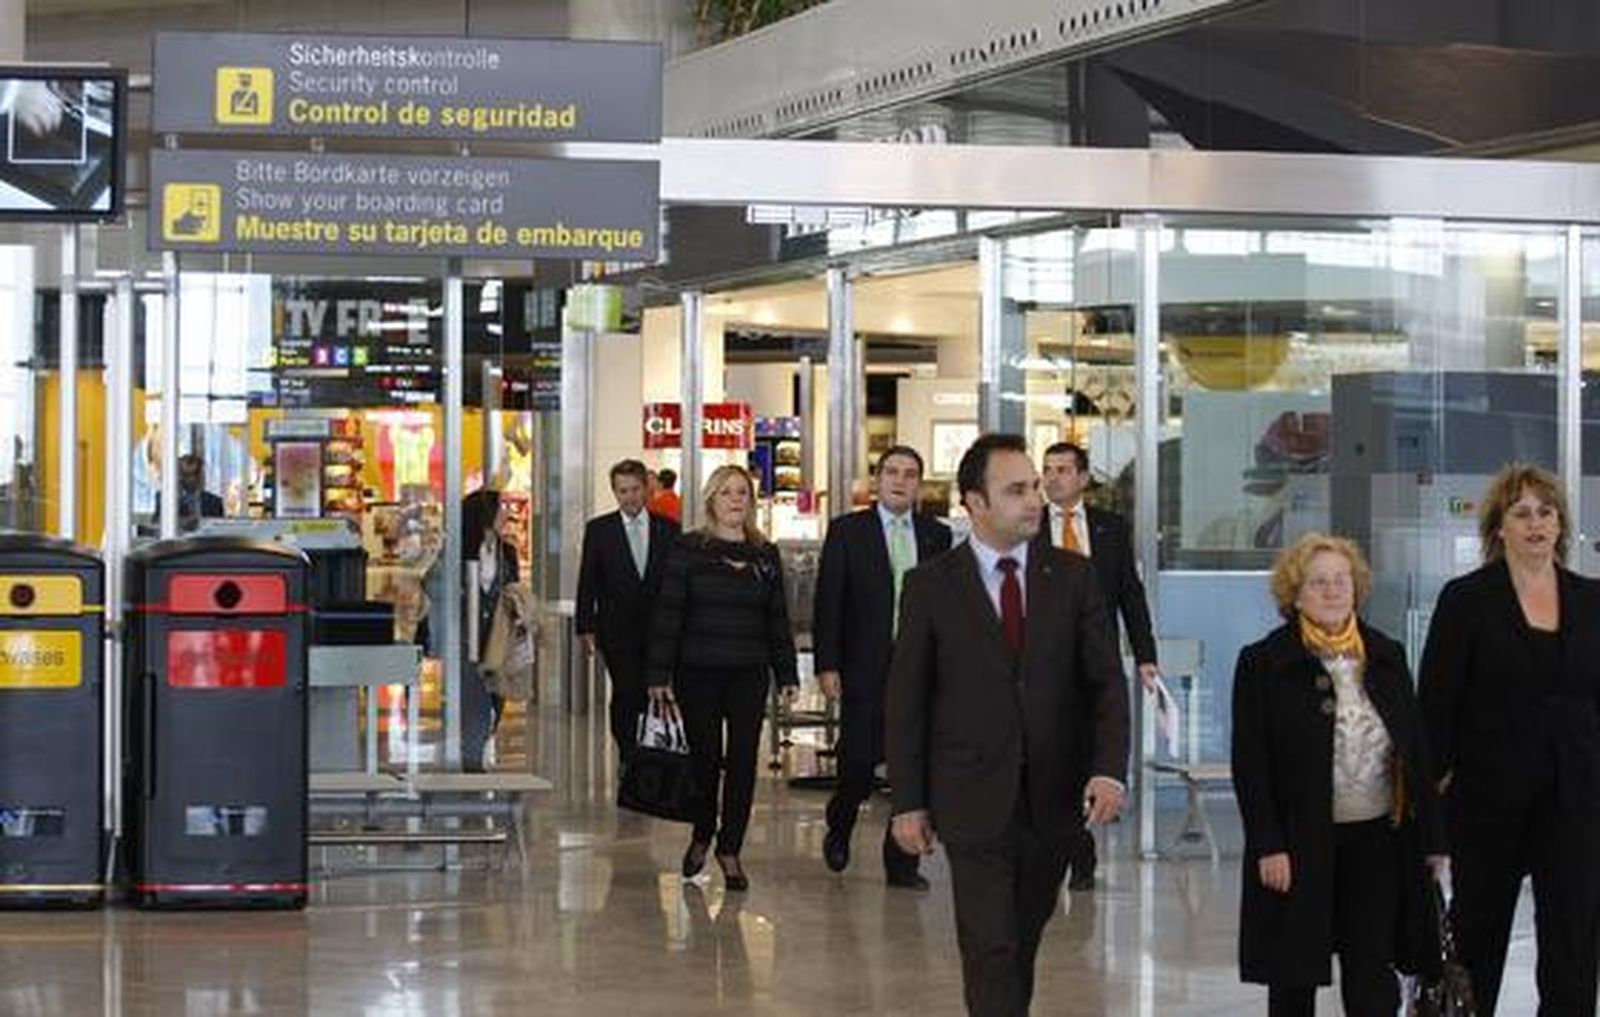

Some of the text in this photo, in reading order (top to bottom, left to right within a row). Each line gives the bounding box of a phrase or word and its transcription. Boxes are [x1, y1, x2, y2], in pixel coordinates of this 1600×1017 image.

[289, 42, 500, 70] Sicherheitskontrolle
[289, 69, 459, 97] Security control
[289, 98, 577, 131] Control de seguridad
[236, 159, 511, 192] Bitte Bordkarte vorzeigen
[236, 186, 505, 217] Show your boarding card
[236, 214, 643, 252] Muestre su tarjeta de embarque
[335, 298, 430, 343] FRE
[645, 417, 744, 435] CLRINS
